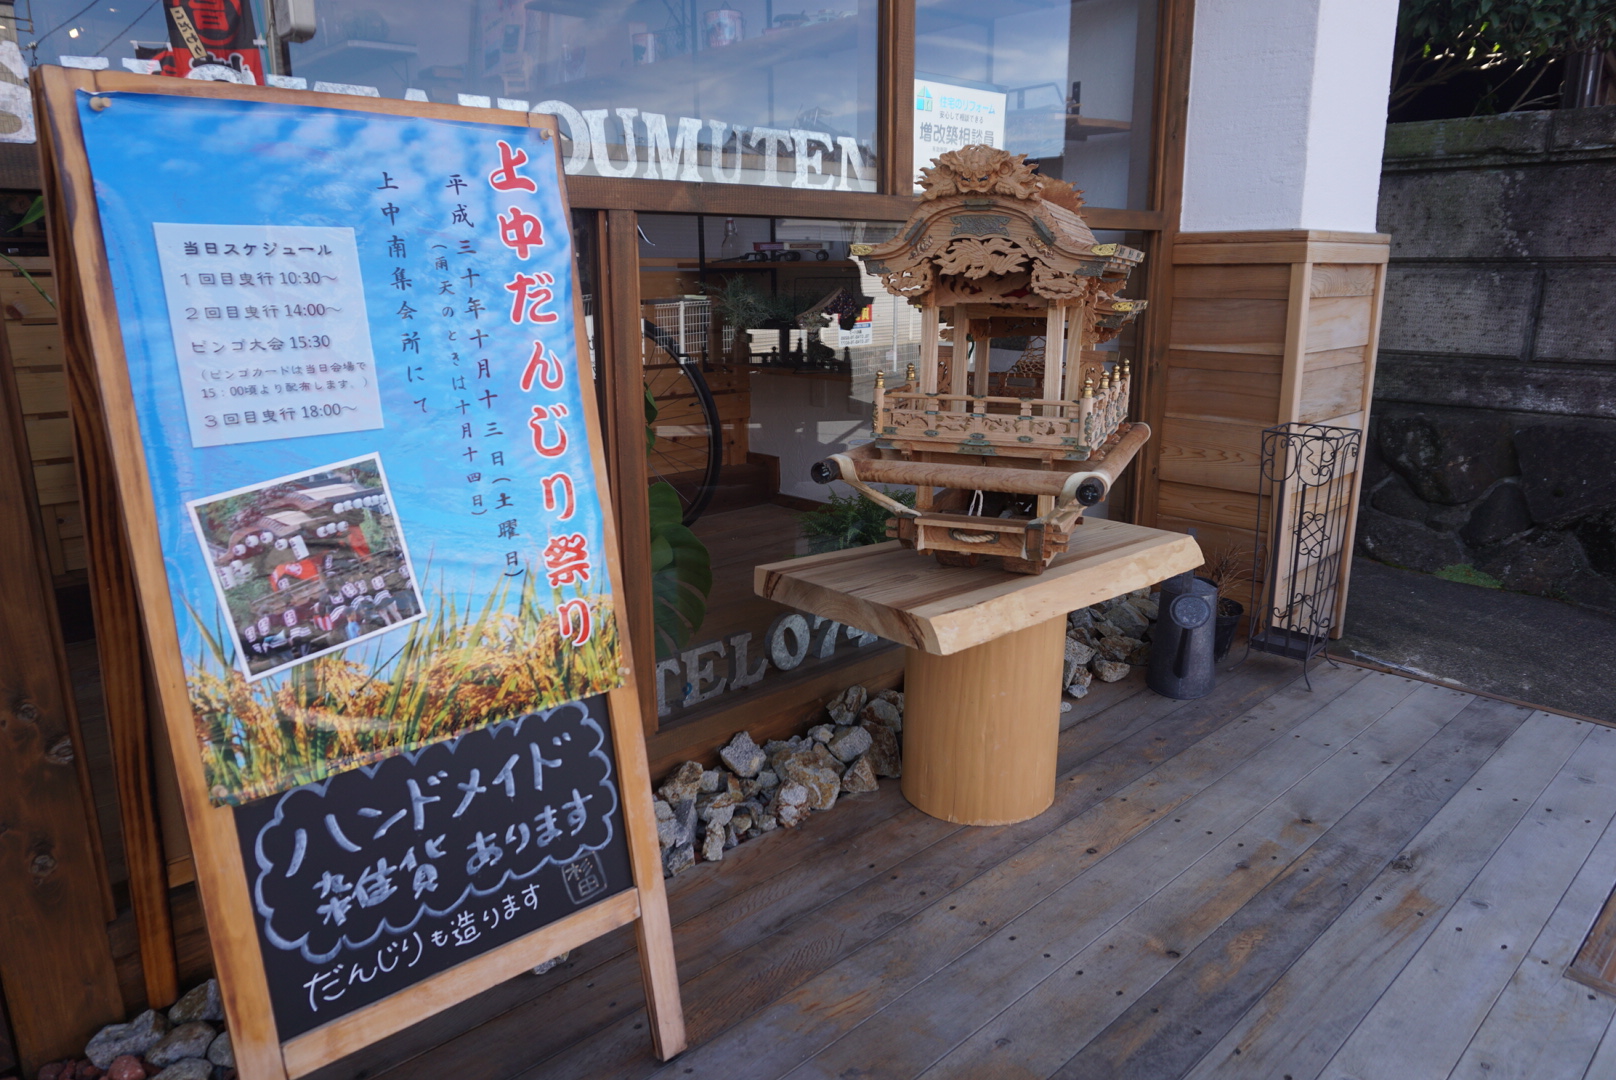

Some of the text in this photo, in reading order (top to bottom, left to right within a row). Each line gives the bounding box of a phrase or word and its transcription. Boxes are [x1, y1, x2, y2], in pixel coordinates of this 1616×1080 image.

[458, 93, 867, 192] OUMUTEN
[919, 121, 994, 147] 増改築相談員
[940, 96, 996, 114] 住宅のリフォーム
[183, 240, 333, 257] 当日スケジュール
[376, 171, 428, 414] 上中南集会所にて
[191, 335, 331, 354] ビンゴ大会 15:30
[488, 139, 592, 648] 上中だんじり祭り
[655, 630, 769, 718] TEL
[285, 731, 572, 878] ハンドメイド
[312, 787, 594, 926] 雑貨 あります
[302, 882, 542, 1012] だんじりも造ります
